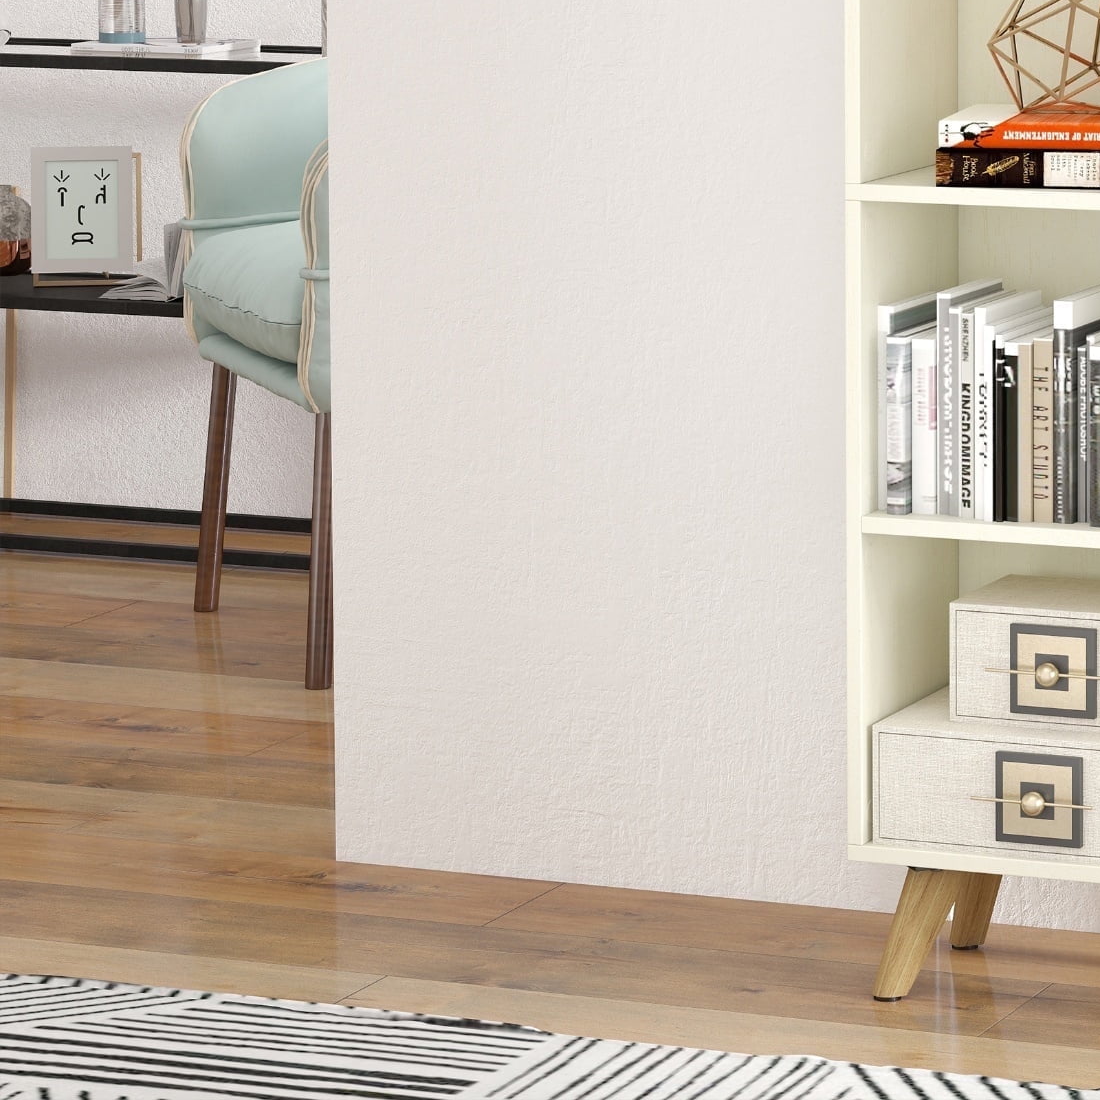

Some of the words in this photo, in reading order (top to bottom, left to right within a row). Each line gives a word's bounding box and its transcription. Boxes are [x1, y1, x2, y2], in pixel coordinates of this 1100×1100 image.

[1003, 130, 1070, 141] ENLIGHTENMENT
[1071, 131, 1082, 141] OF
[1033, 366, 1049, 392] THE
[1033, 405, 1049, 432] ART
[1033, 444, 1049, 500] STUDIO
